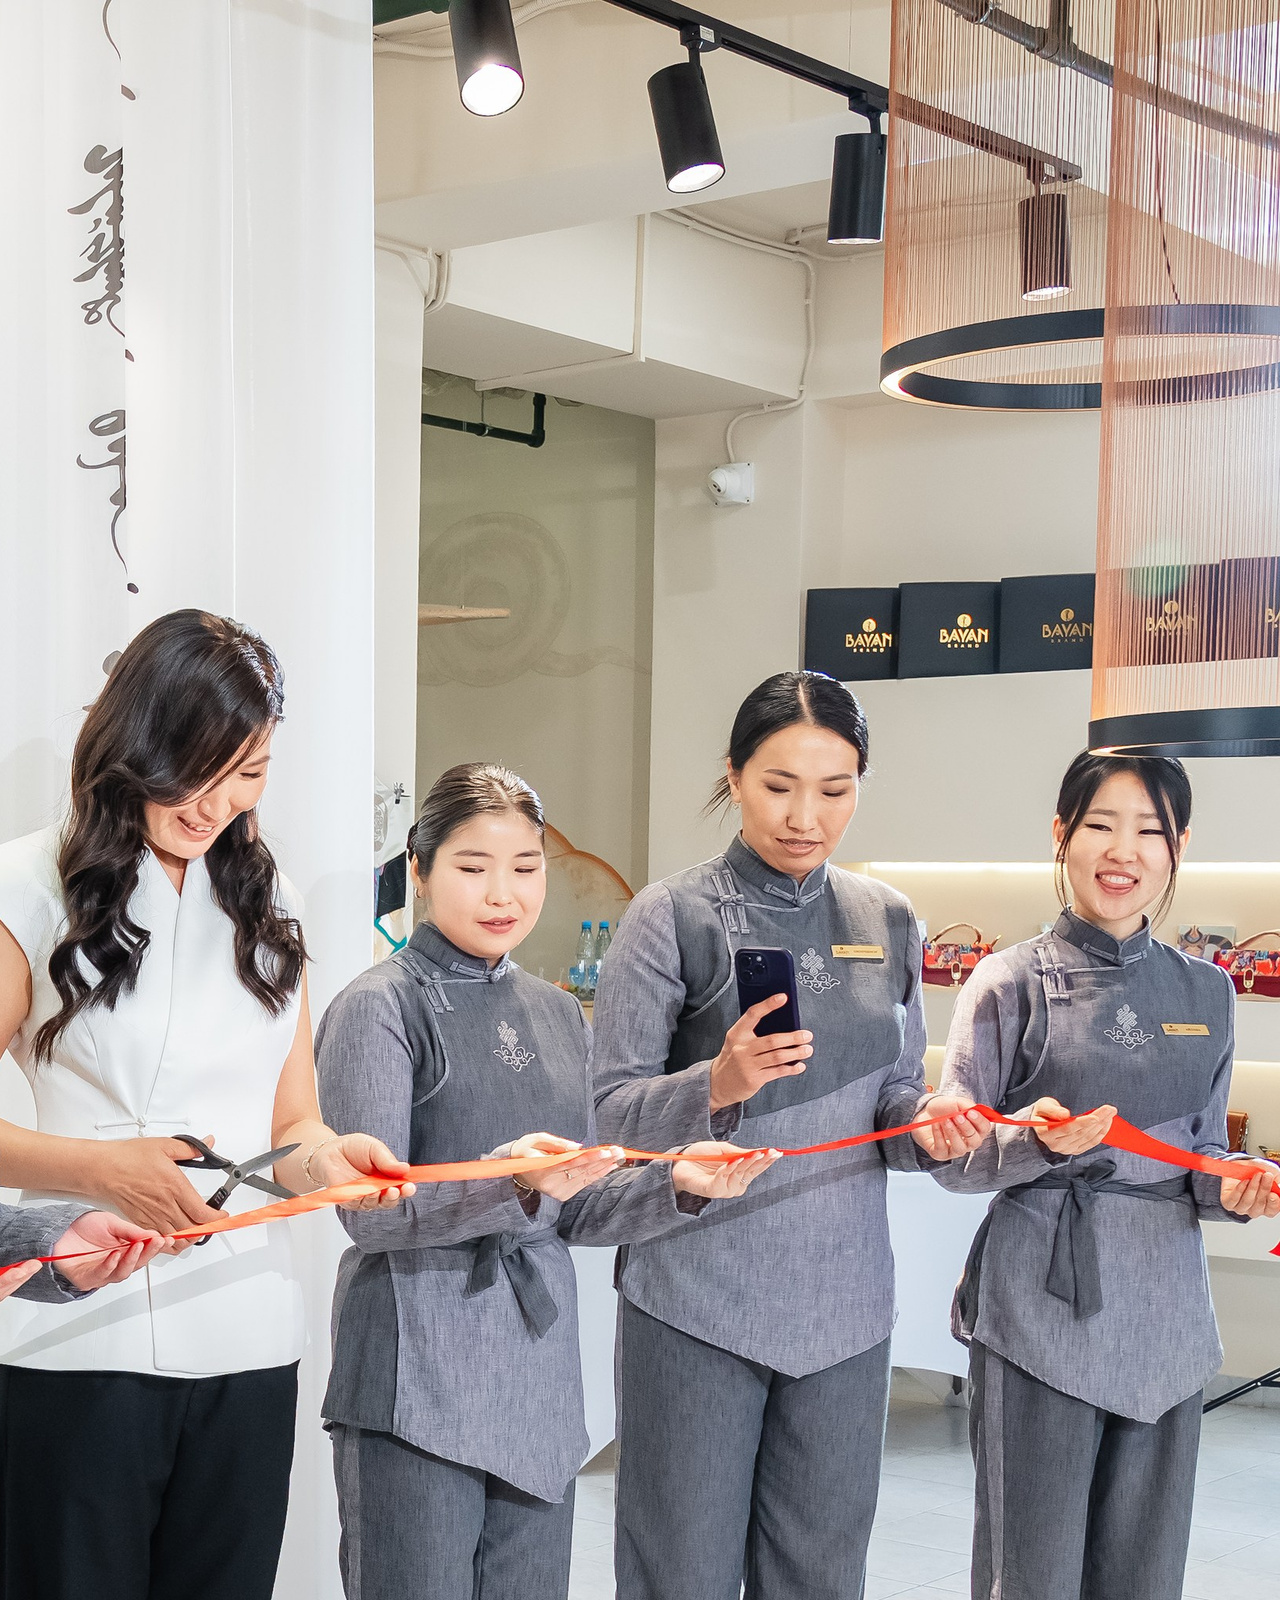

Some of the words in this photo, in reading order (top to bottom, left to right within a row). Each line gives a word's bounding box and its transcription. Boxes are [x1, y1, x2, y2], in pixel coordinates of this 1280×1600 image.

[939, 628, 990, 644] BAYAN
[1042, 622, 1093, 638] BAYAN
[845, 632, 892, 648] BAYAN
